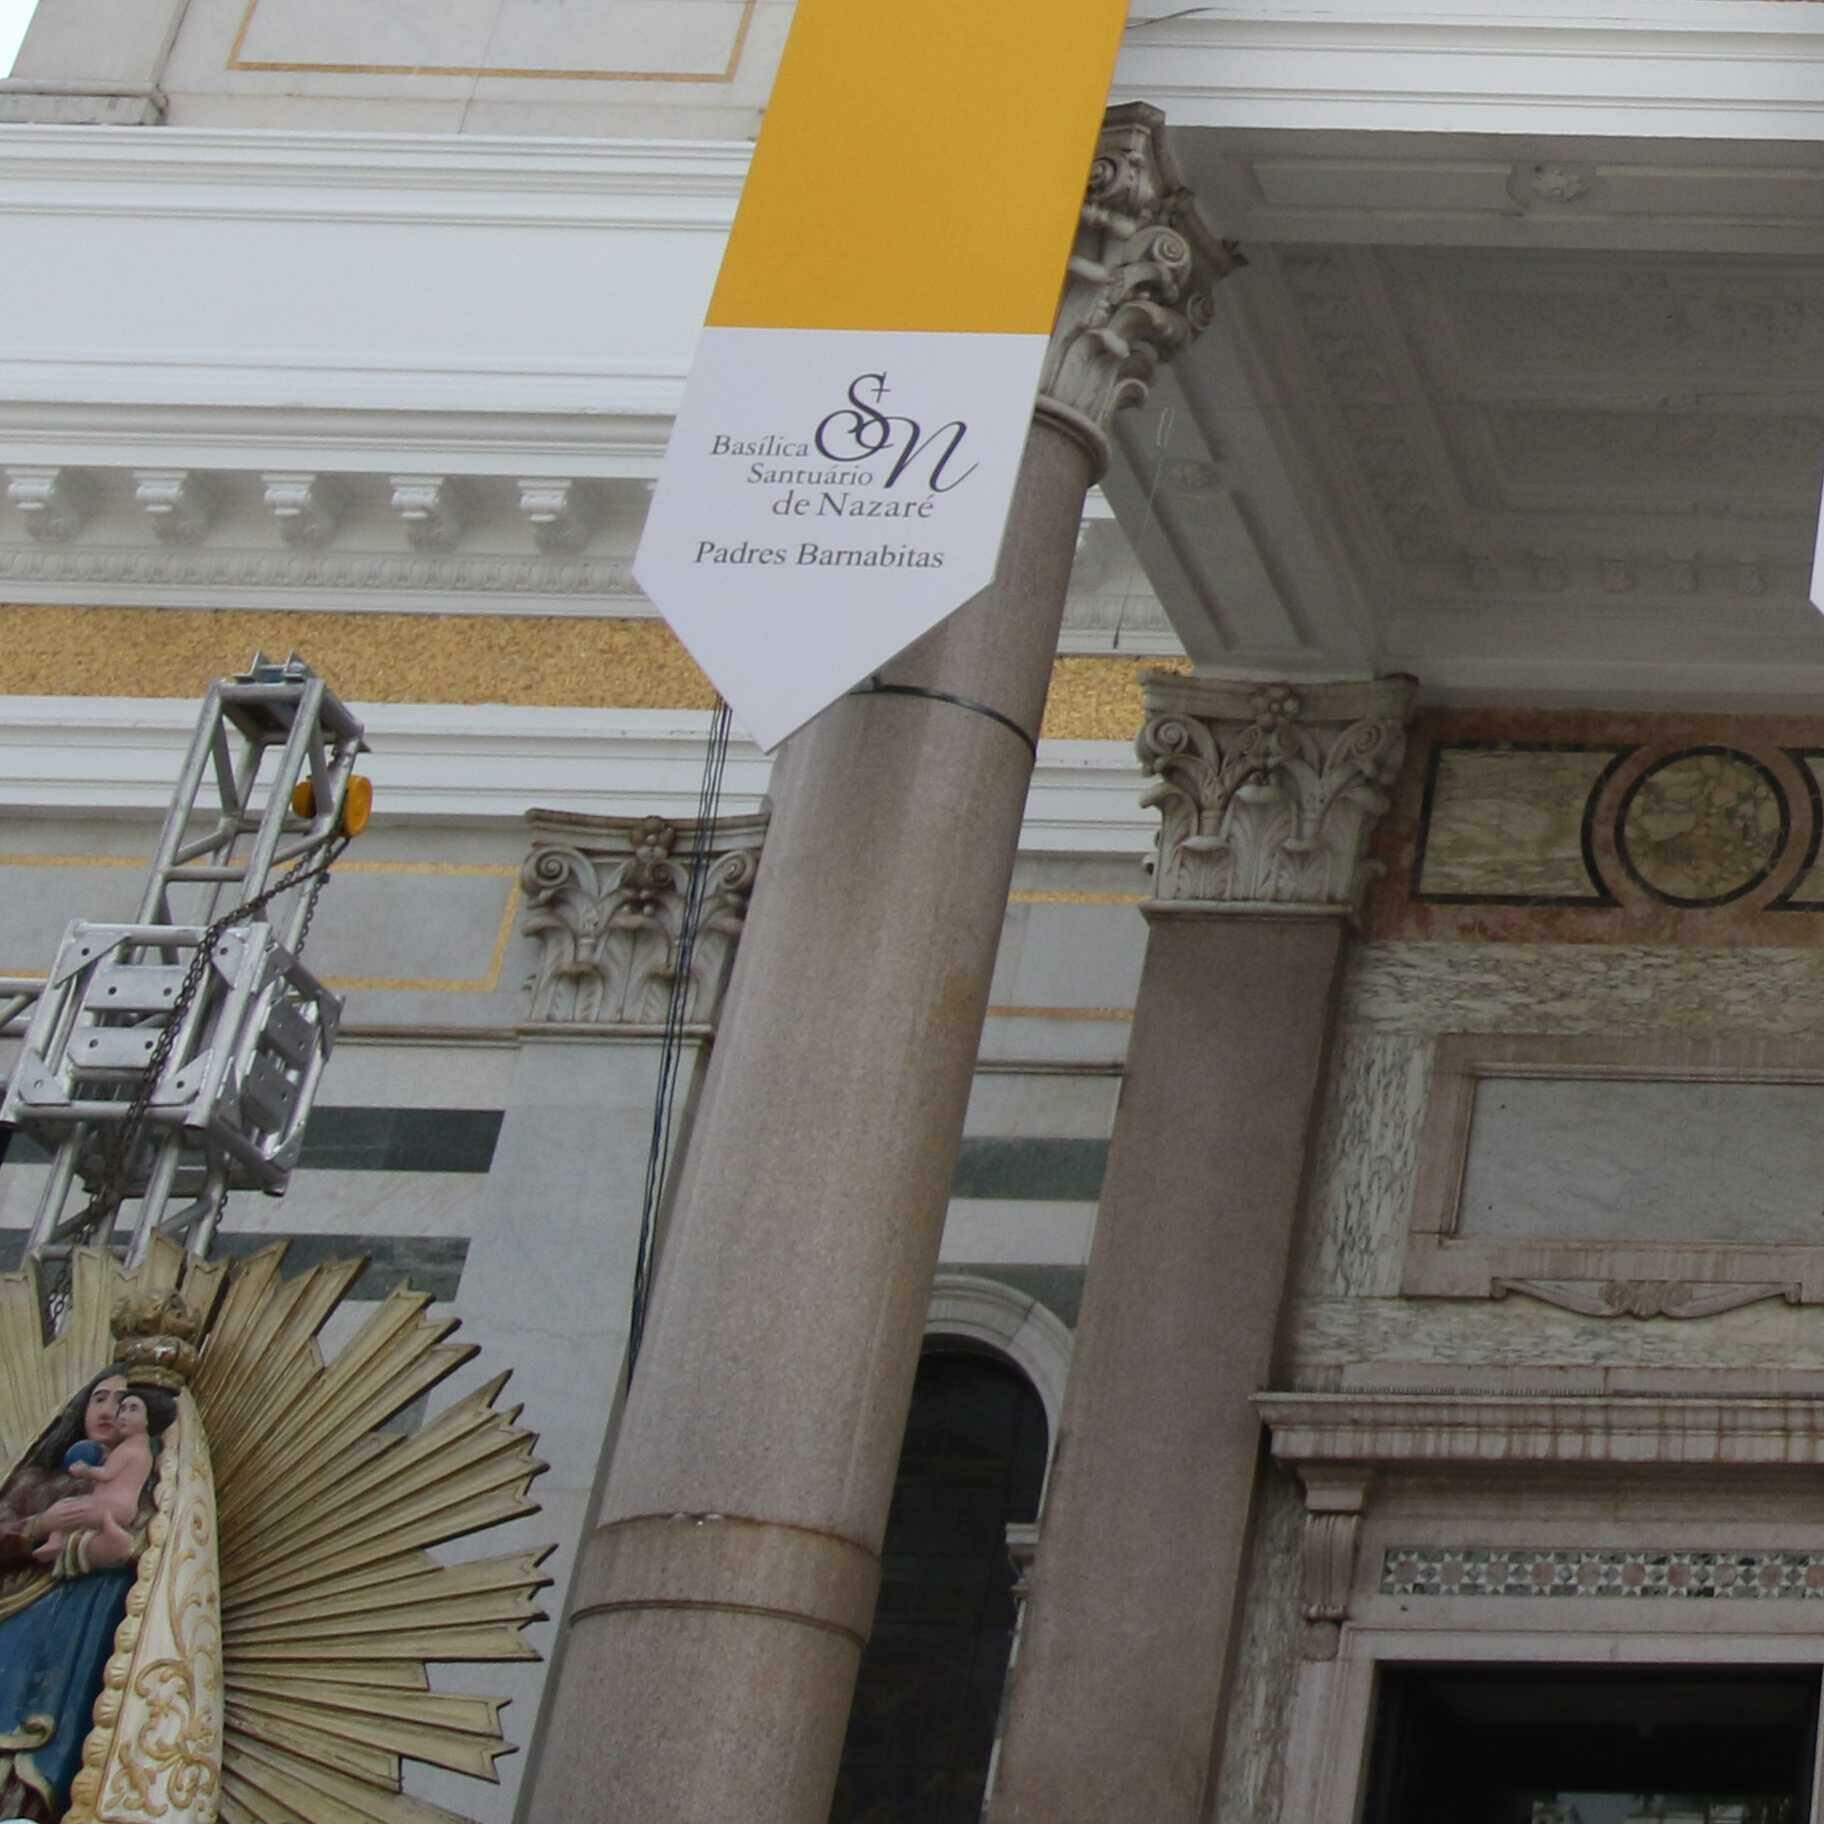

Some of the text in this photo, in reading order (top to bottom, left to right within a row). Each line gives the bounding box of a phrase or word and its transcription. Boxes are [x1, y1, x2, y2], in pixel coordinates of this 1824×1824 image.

[711, 434, 809, 457] Basílica
[747, 462, 873, 486] Santuário
[772, 490, 934, 518] de Nazaré
[694, 541, 944, 569] Padres Barnabitas
